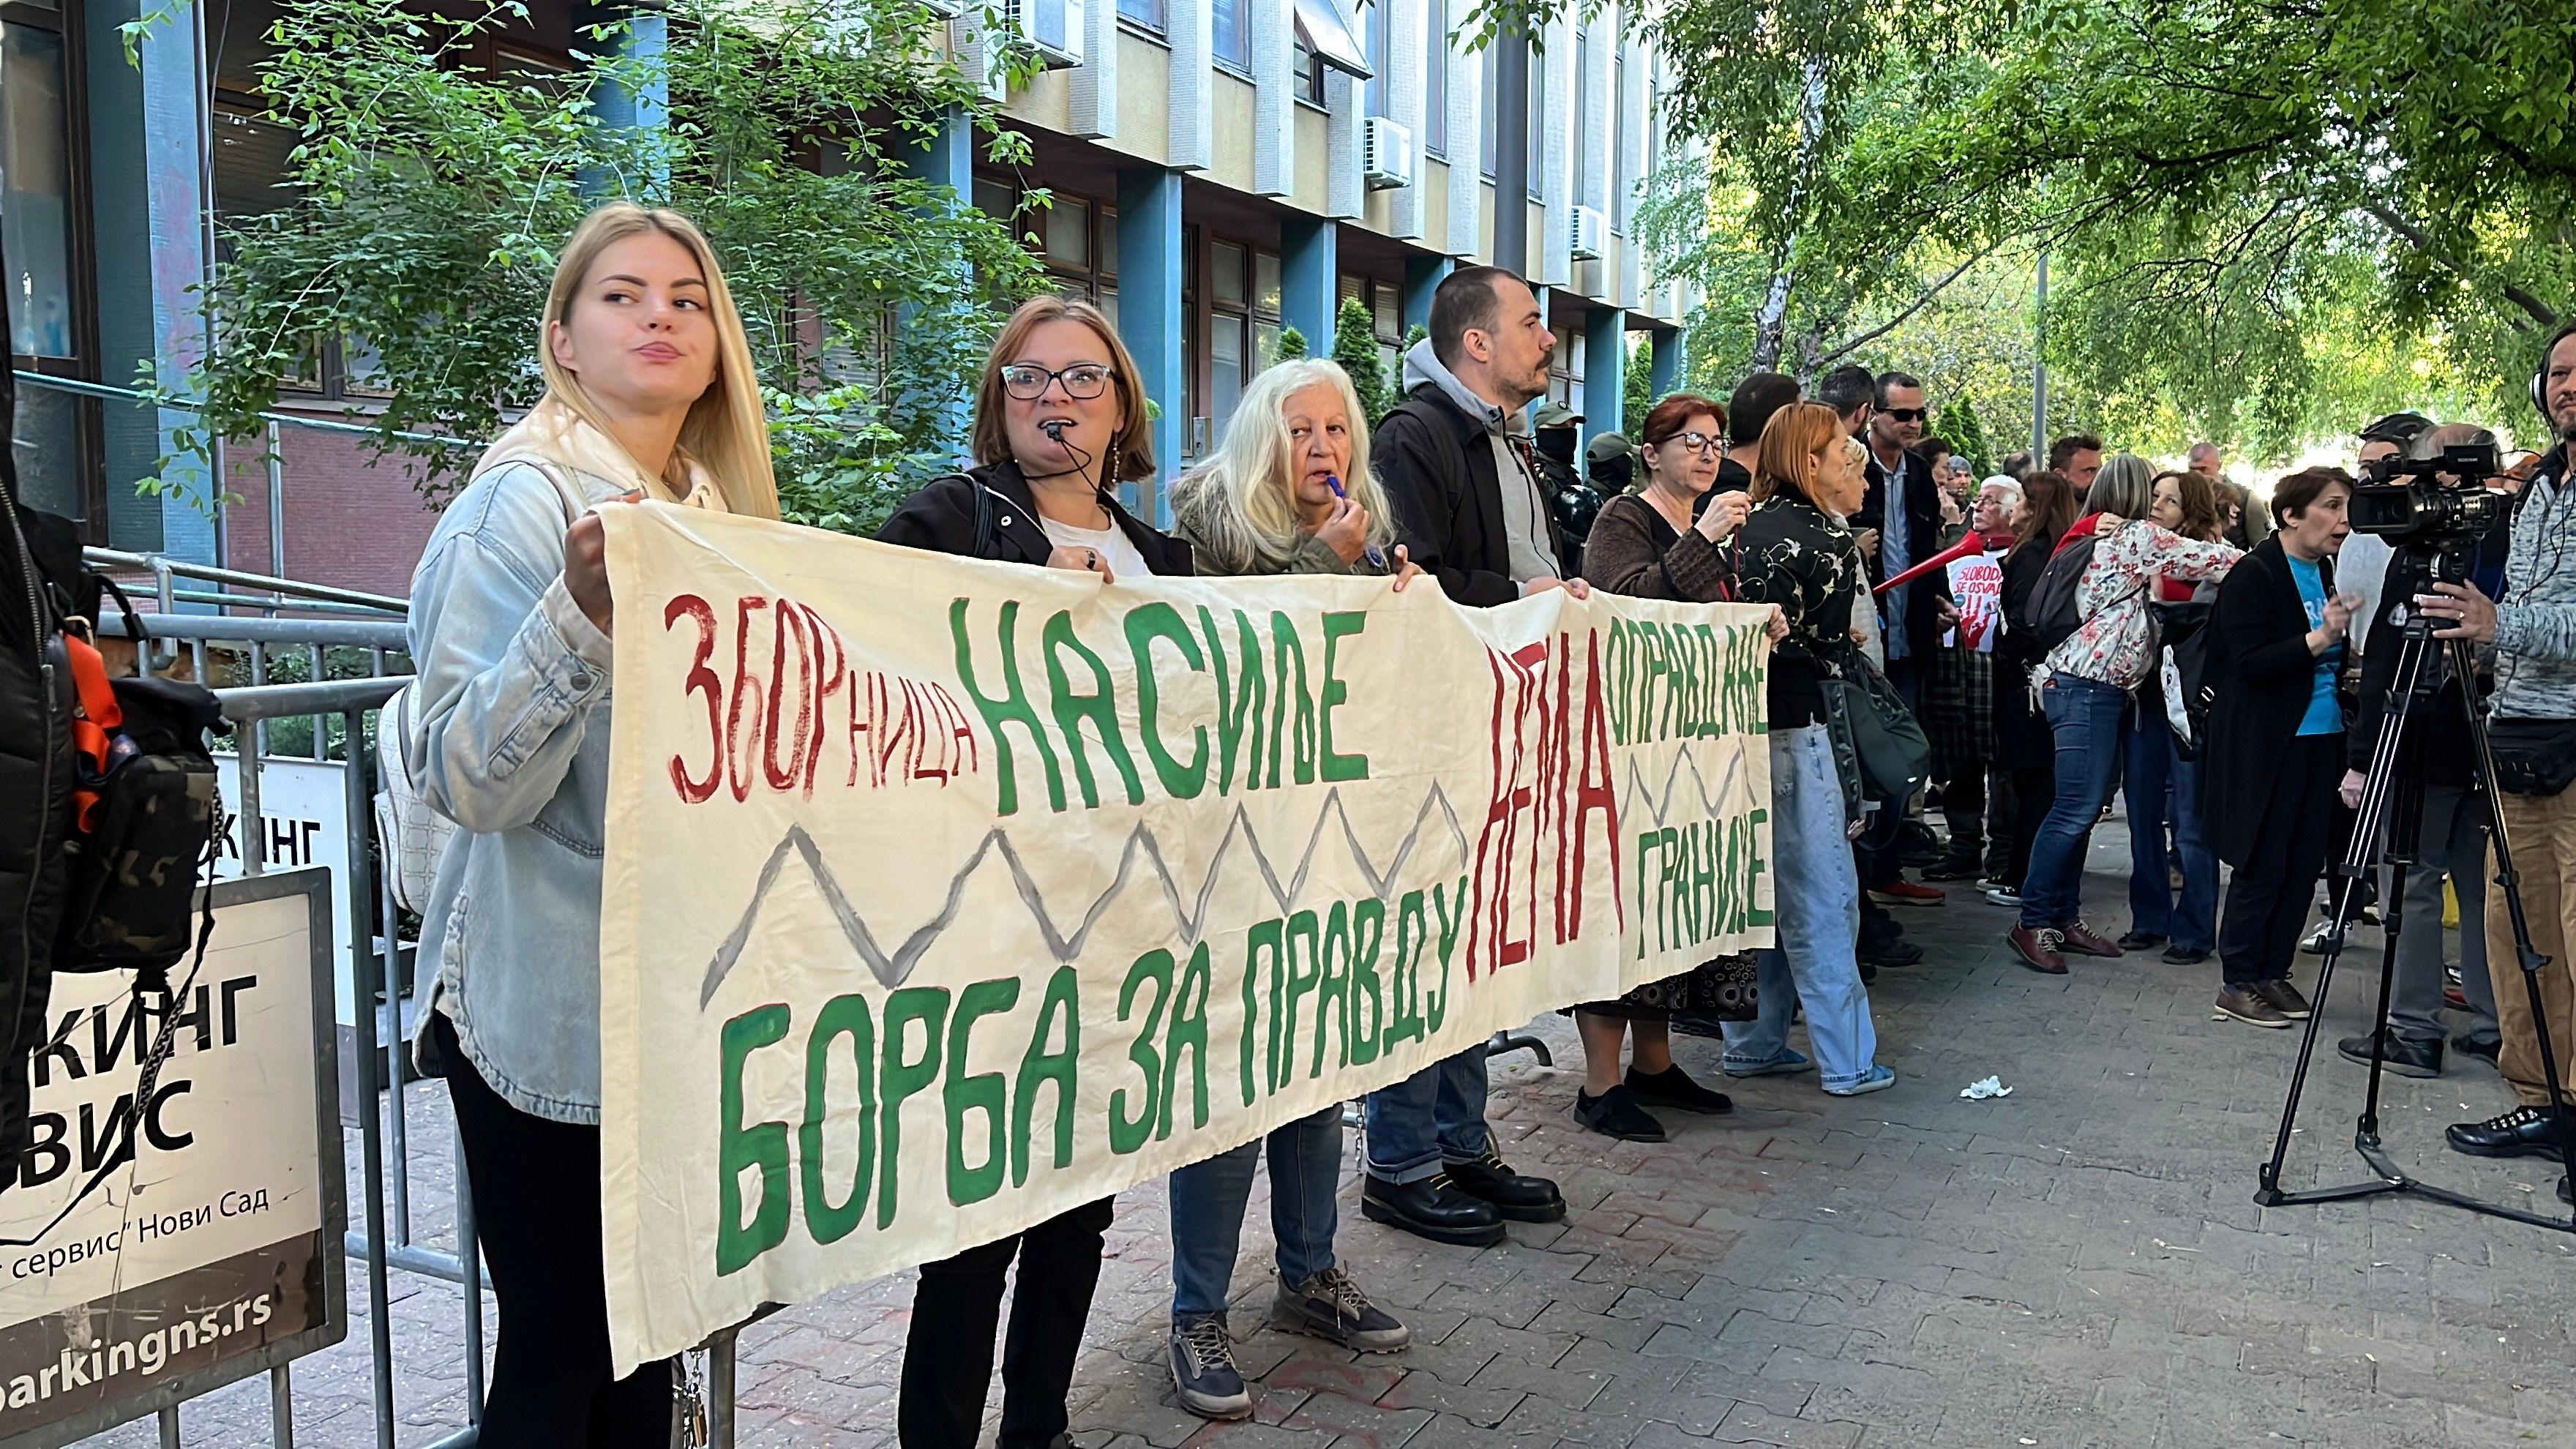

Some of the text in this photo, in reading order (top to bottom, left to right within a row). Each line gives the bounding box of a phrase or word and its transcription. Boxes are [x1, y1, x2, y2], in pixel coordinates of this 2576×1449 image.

[1954, 582, 1967, 594] SE
[716, 875, 1468, 1277] БОРБА ЗА ПРАВДУ
[138, 1205, 211, 1243] Нови
[219, 1188, 269, 1218] Сад
